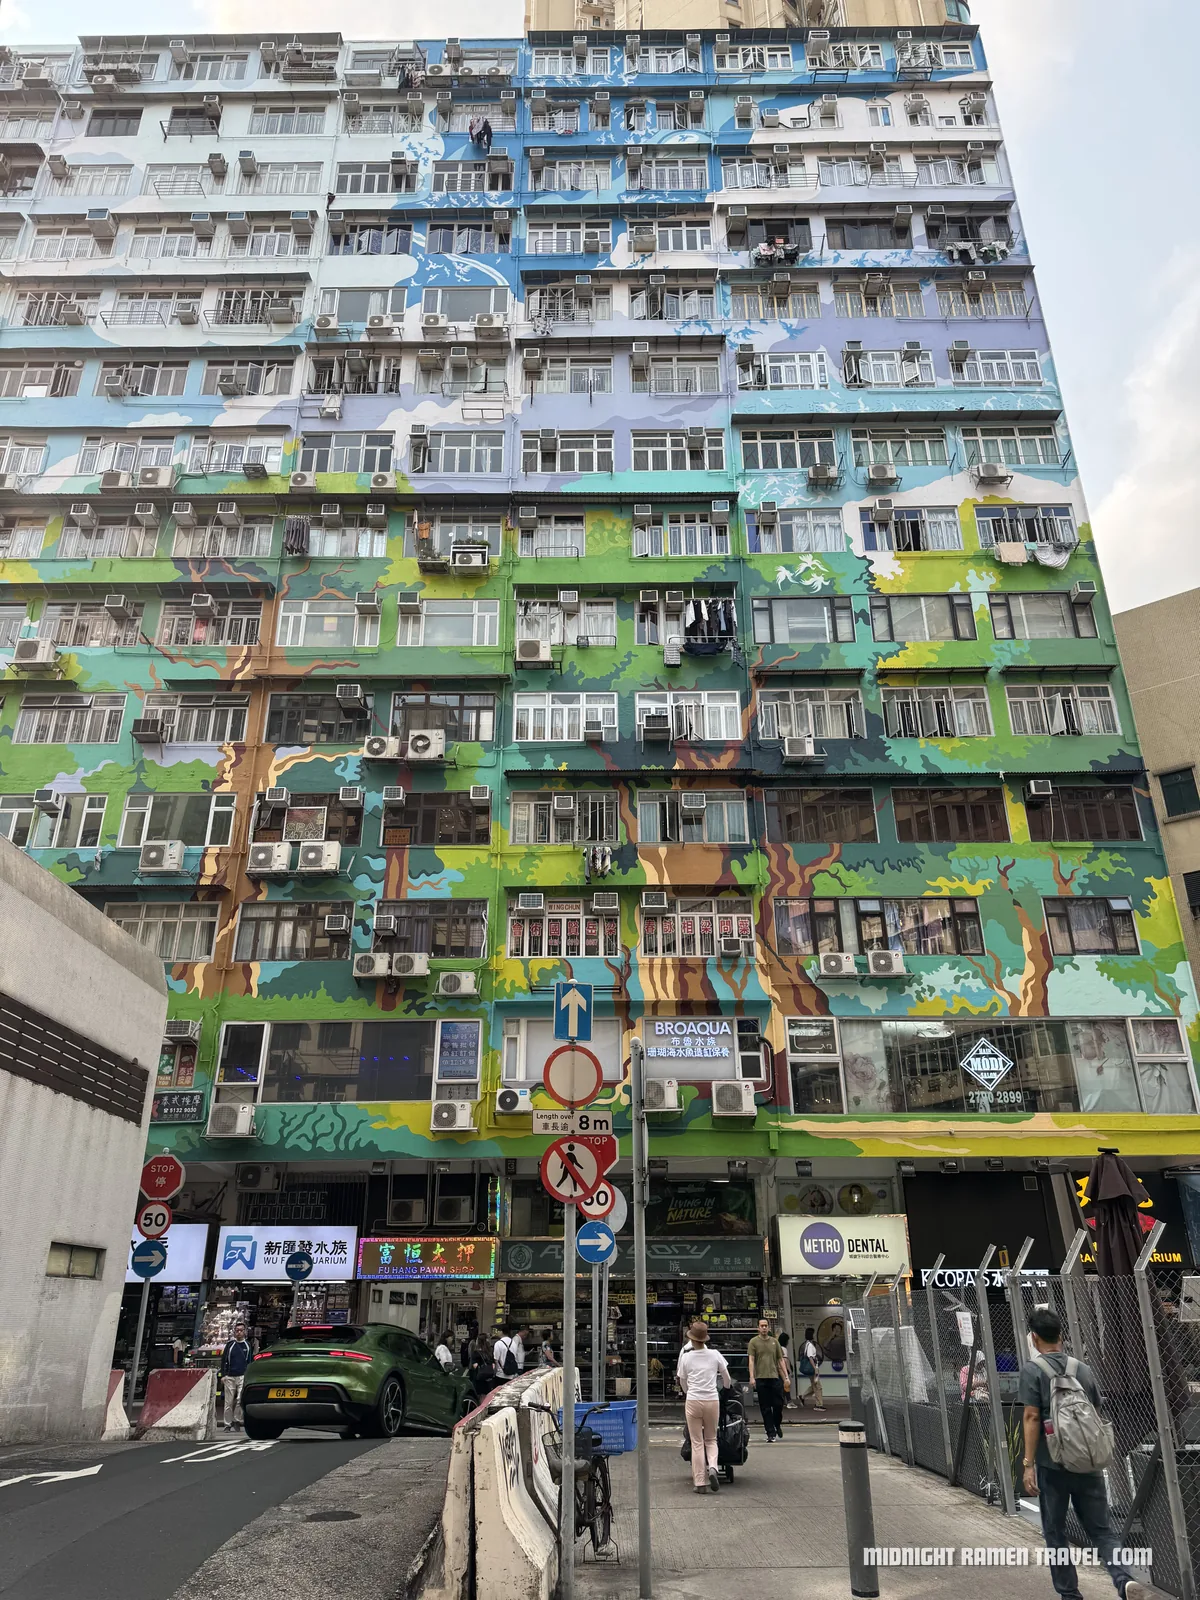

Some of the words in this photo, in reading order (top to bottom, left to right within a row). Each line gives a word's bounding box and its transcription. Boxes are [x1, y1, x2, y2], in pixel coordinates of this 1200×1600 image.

[655, 1021, 732, 1036] BROAQUA
[670, 1036, 717, 1047] 布魯水族
[161, 1094, 201, 1107] 泰式按摩
[996, 1090, 1022, 1104] 2899
[536, 1113, 558, 1121] Length
[578, 1115, 590, 1131] 8
[593, 1118, 609, 1131] m
[542, 1122, 569, 1132] 車長逾
[584, 1136, 608, 1145] TOP
[150, 1164, 175, 1173] STOP
[155, 1176, 167, 1188] 停
[142, 1212, 166, 1228] 50
[666, 1207, 713, 1222] NATURE
[264, 1240, 348, 1256] 新匯發水族
[803, 1238, 841, 1253] METRO
[847, 1238, 889, 1253] DENTAL
[263, 1256, 278, 1265] WU
[378, 1266, 390, 1274] FU
[391, 1266, 418, 1274] HANG
[419, 1266, 446, 1274] PAWN
[449, 1266, 475, 1274] SHOP
[275, 1389, 286, 1398] GA
[289, 1389, 301, 1397] 39
